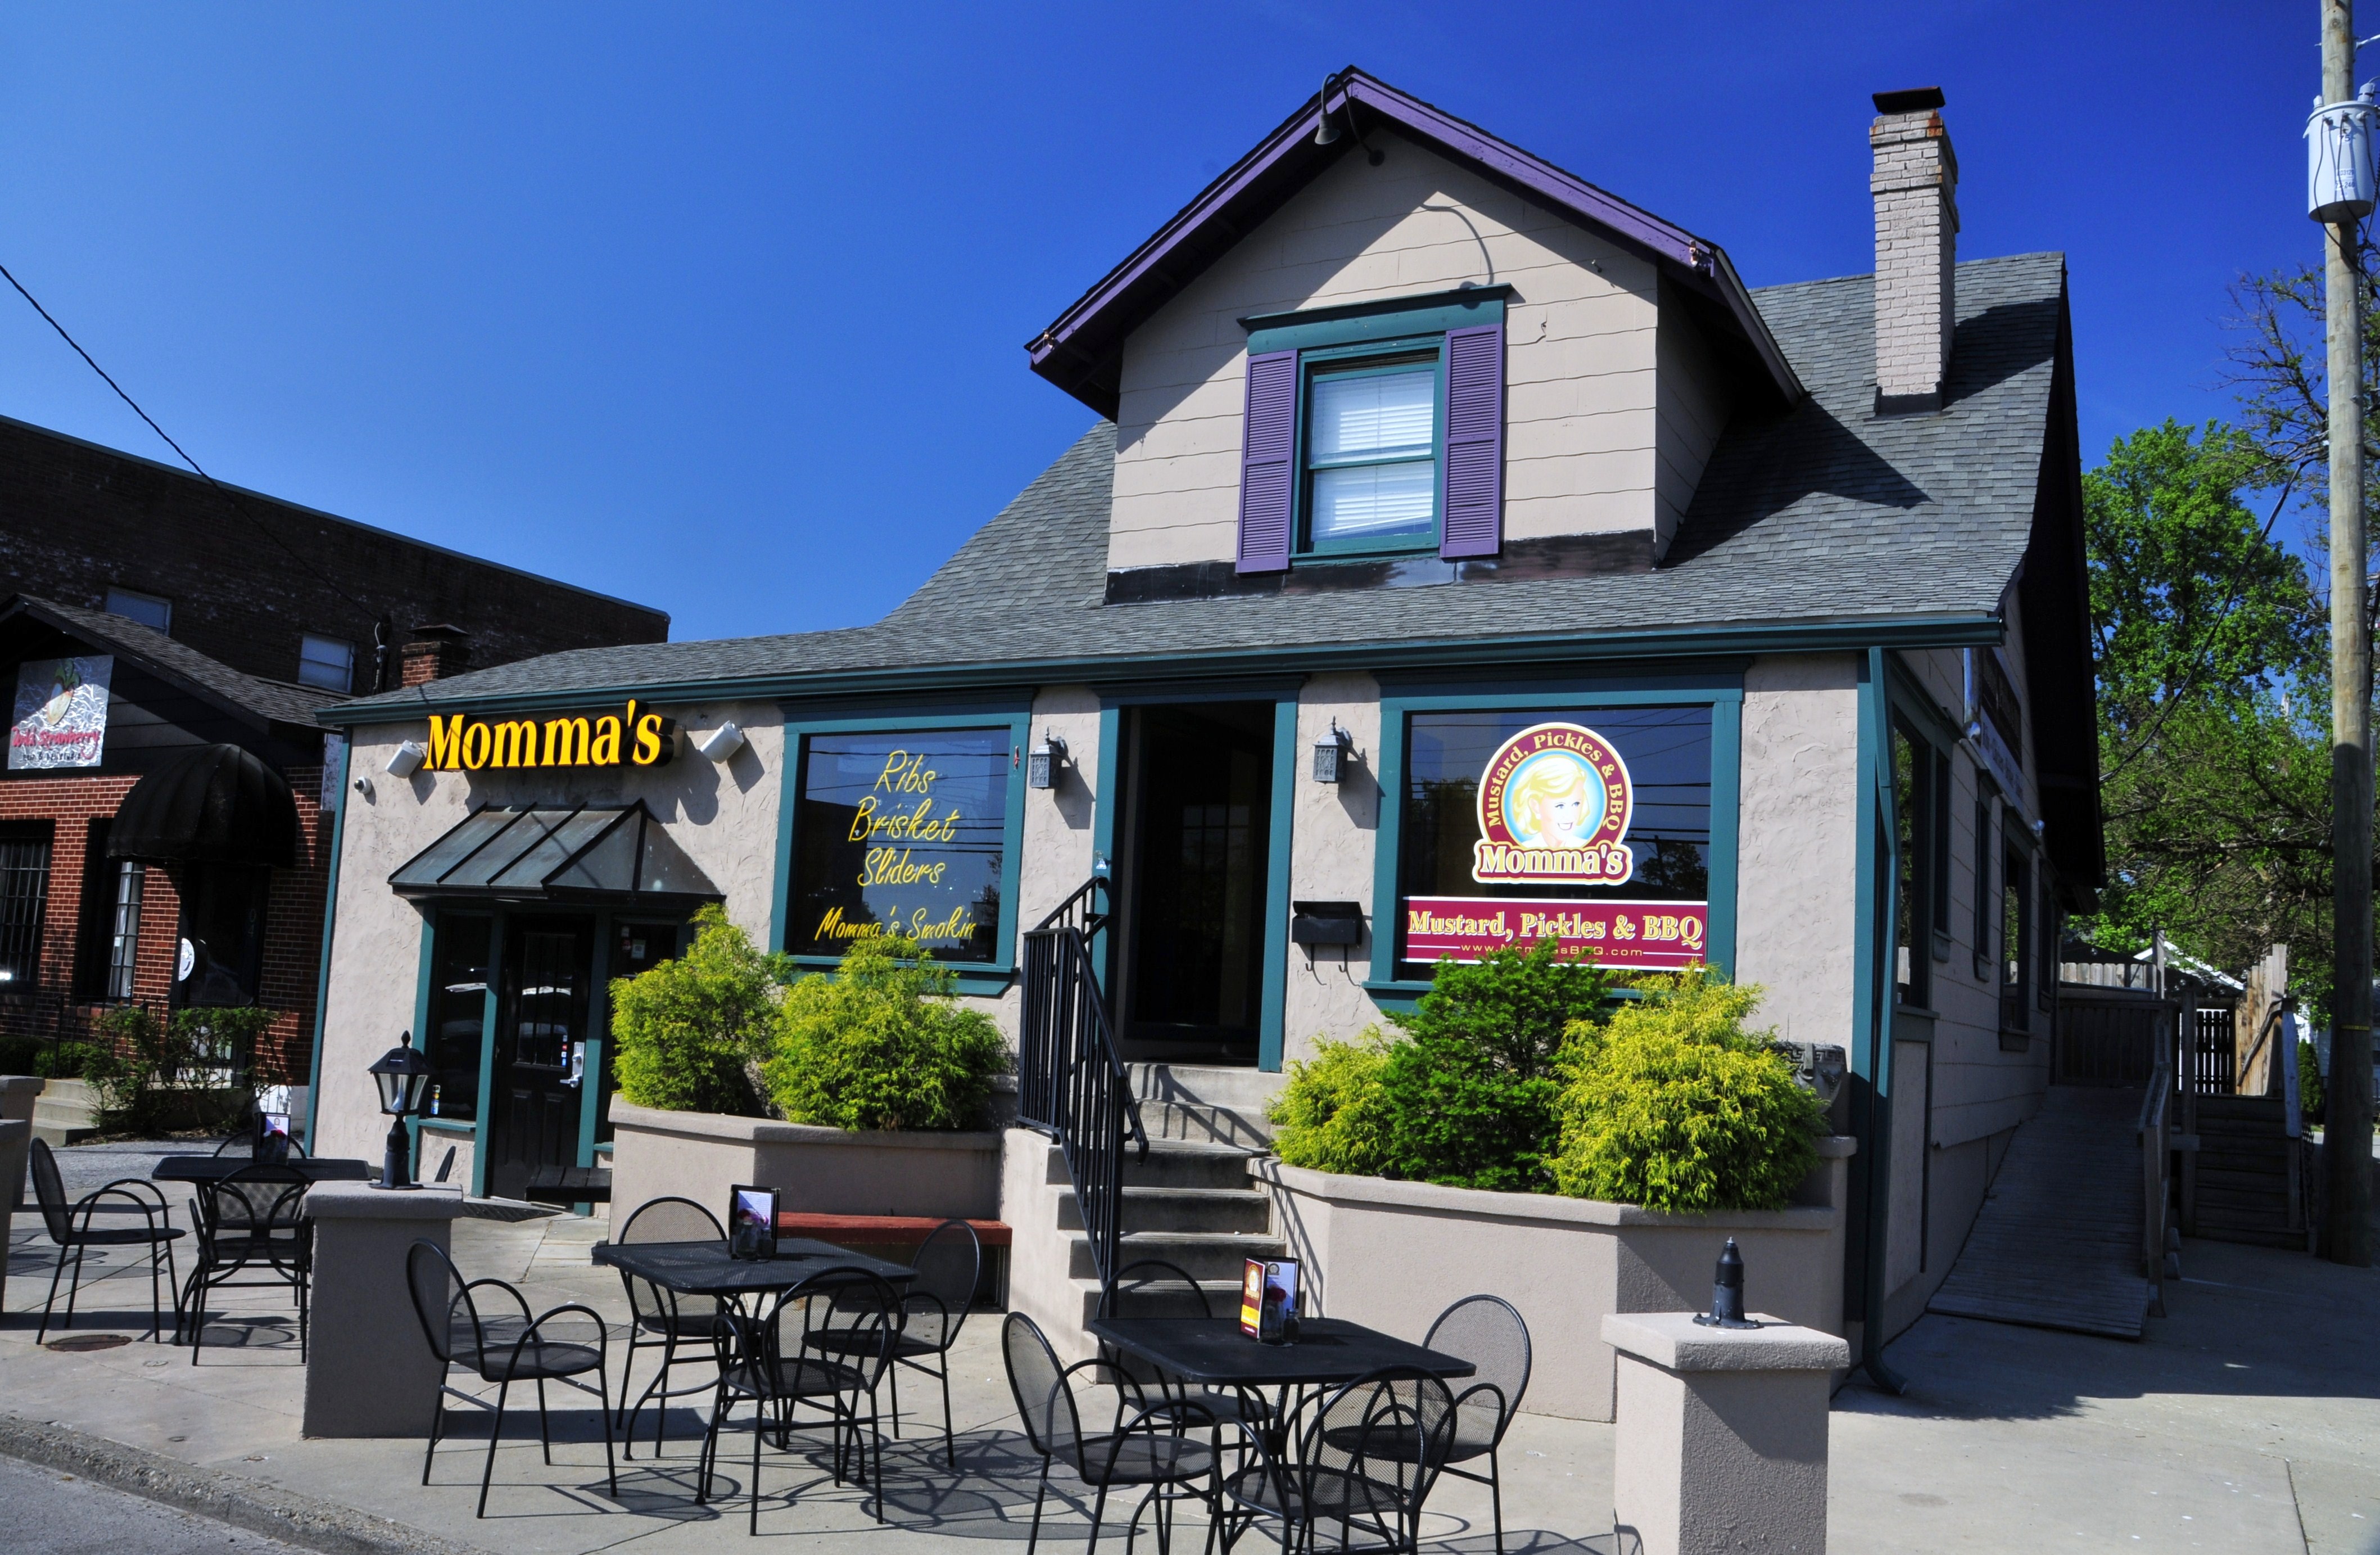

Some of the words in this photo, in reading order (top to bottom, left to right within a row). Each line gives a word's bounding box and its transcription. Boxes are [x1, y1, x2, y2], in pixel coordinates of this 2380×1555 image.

[422, 698, 662, 771] Momma's
[1533, 731, 1602, 762] Pickles
[874, 750, 936, 793] Ribs
[1487, 746, 1529, 828] Mustard,
[1601, 763, 1615, 779] &
[848, 796, 960, 842] Brisket
[1602, 783, 1623, 831] BBQ
[857, 847, 945, 887] Sliders
[1480, 844, 1623, 875] Momma's
[815, 906, 899, 941] Momma's
[907, 906, 976, 941] Smokin
[1408, 910, 1514, 941] Mustard,
[1519, 911, 1606, 939] Pickles
[1612, 914, 1635, 940] &
[1642, 915, 1702, 950] BBQ
